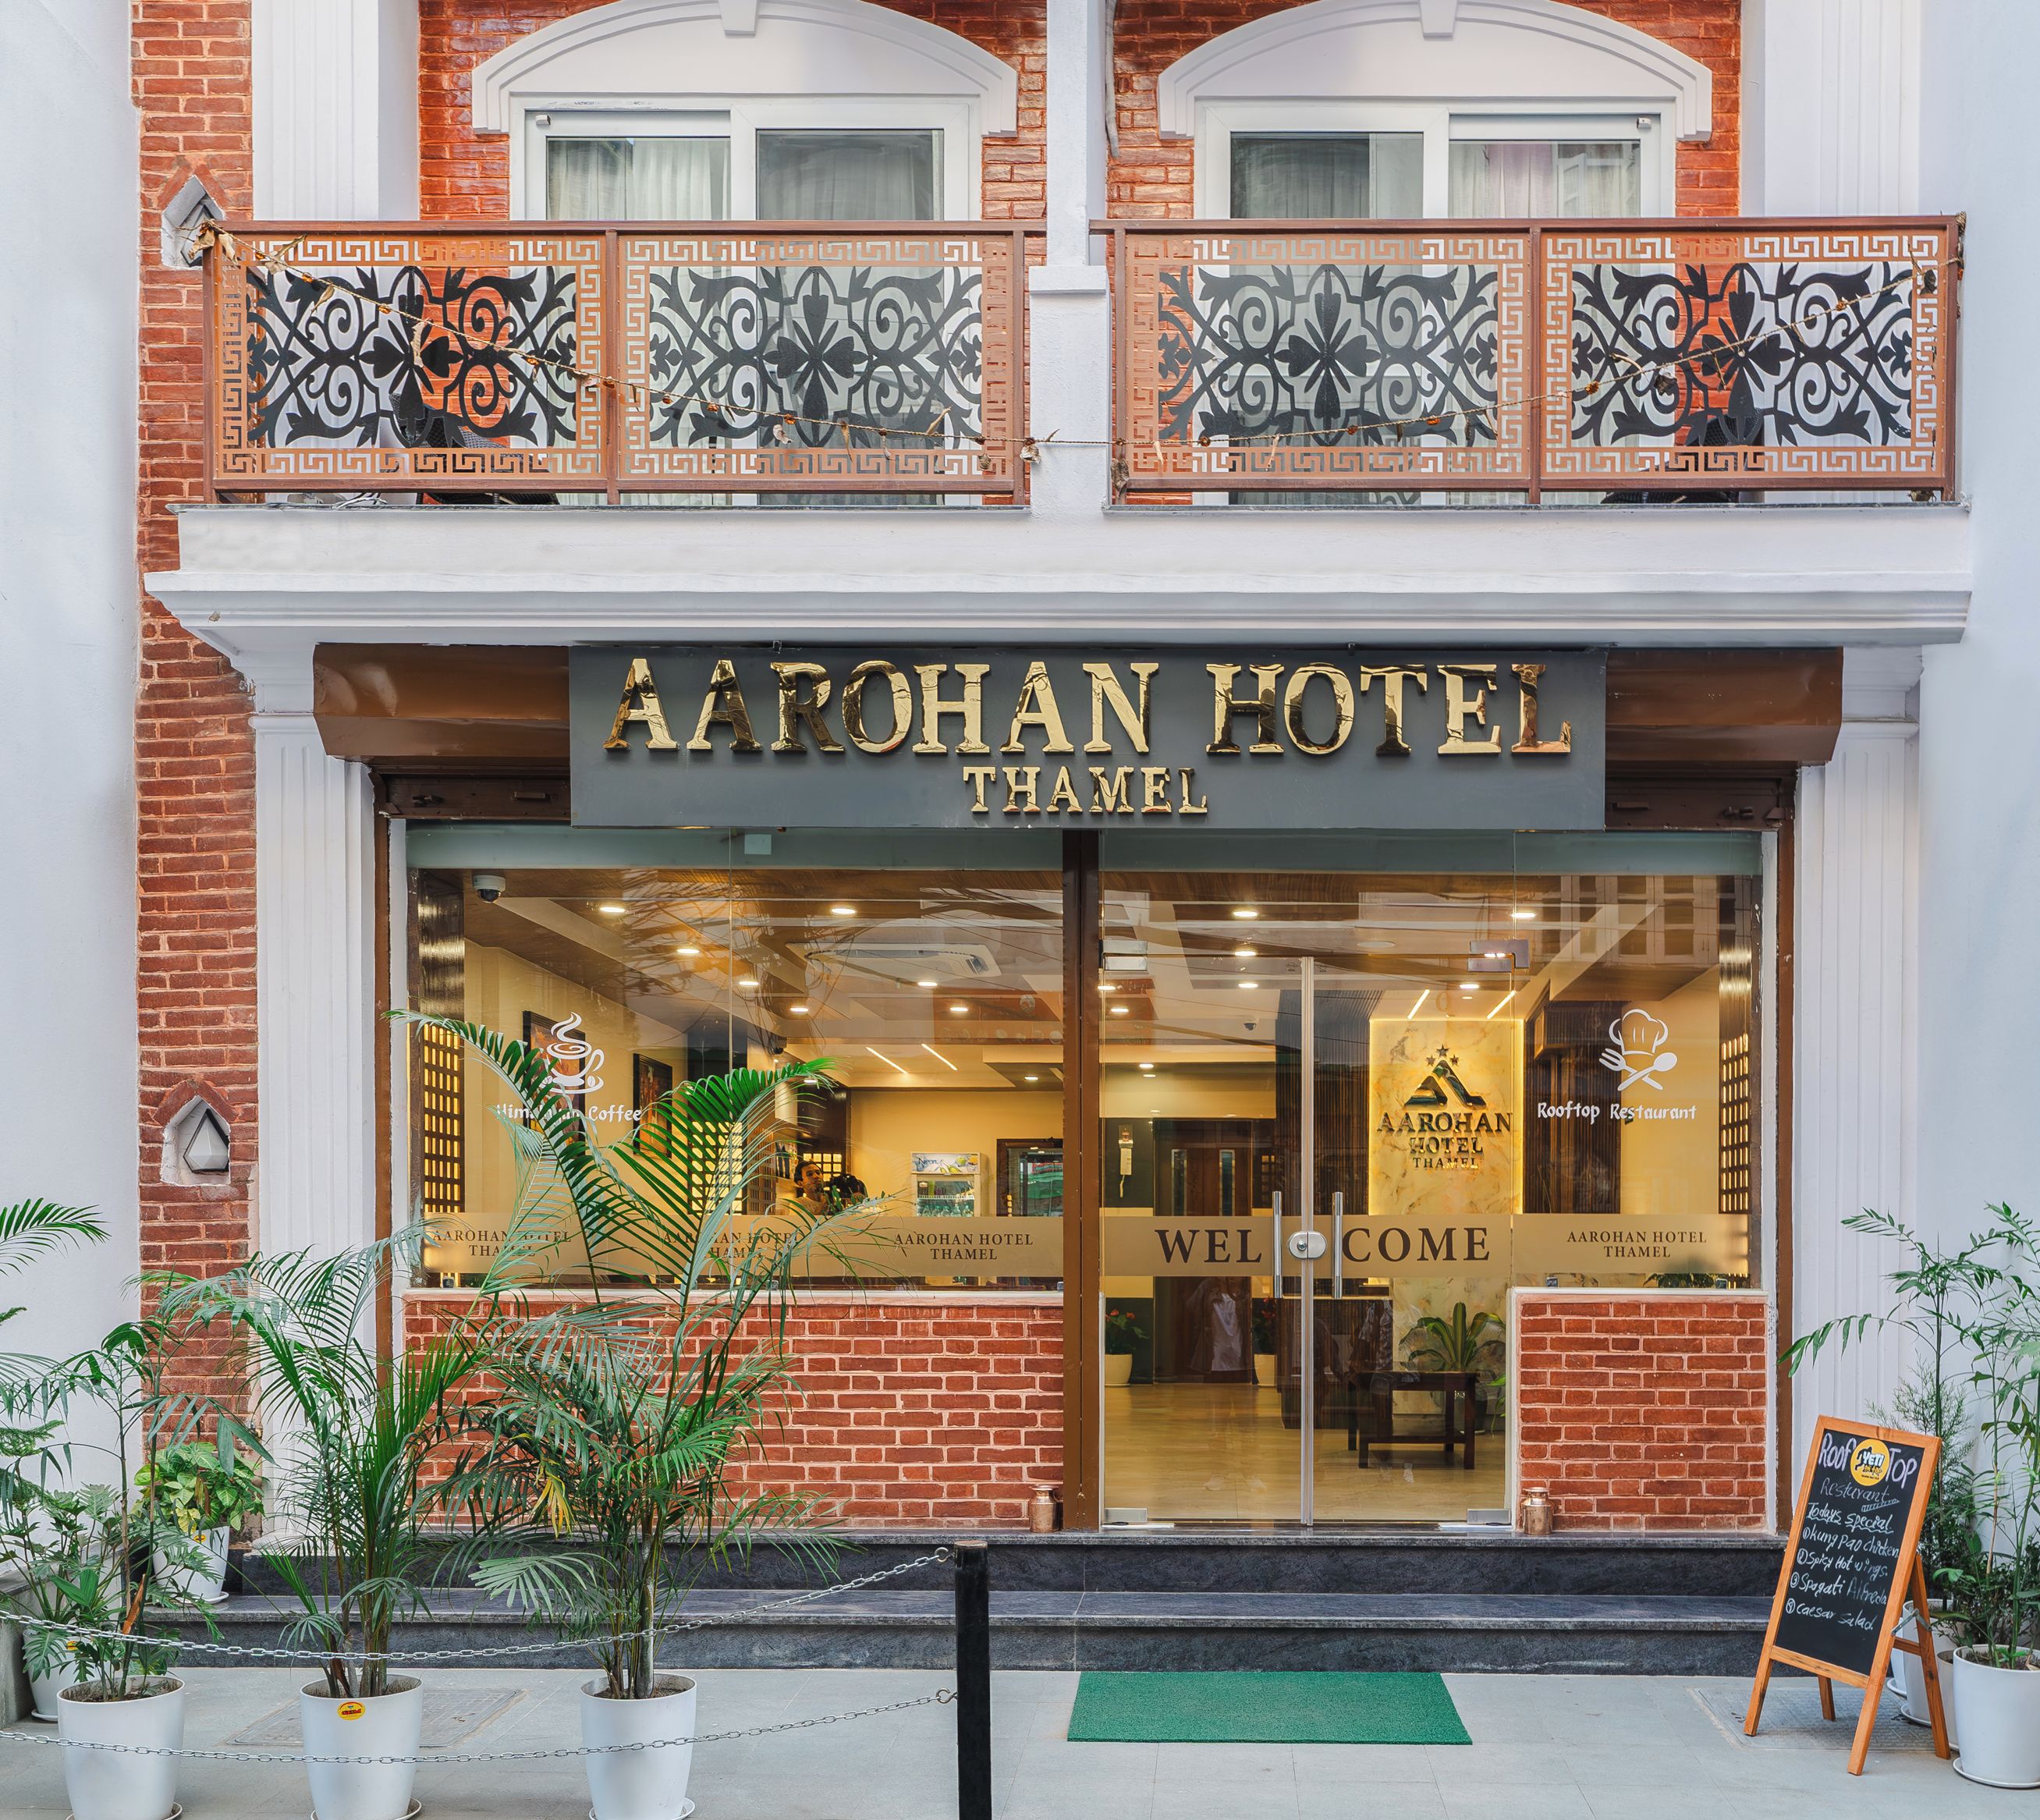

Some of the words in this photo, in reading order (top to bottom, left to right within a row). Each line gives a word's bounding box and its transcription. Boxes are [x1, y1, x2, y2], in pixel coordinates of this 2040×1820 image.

[603, 658, 1158, 756] AAROHAN
[1205, 662, 1573, 756] HOTEL
[962, 765, 1208, 815] THAMEL
[588, 1104, 642, 1123] Coffee
[1538, 1100, 1600, 1125] Rooftop
[1609, 1103, 1698, 1120] Restaurant
[1376, 1112, 1513, 1132] AAROHAN
[1409, 1137, 1484, 1155] HOTEL
[1413, 1158, 1479, 1169] THAMEL
[893, 1233, 974, 1245] AAROHAN
[979, 1233, 1034, 1245] HOTEL
[1154, 1229, 1262, 1264] WEL
[1342, 1226, 1491, 1263] COME
[1566, 1230, 1647, 1243] AAROHAN
[1652, 1230, 1707, 1243] HOTEL
[930, 1248, 998, 1260] THAMEL
[1603, 1246, 1671, 1258] THAMEL
